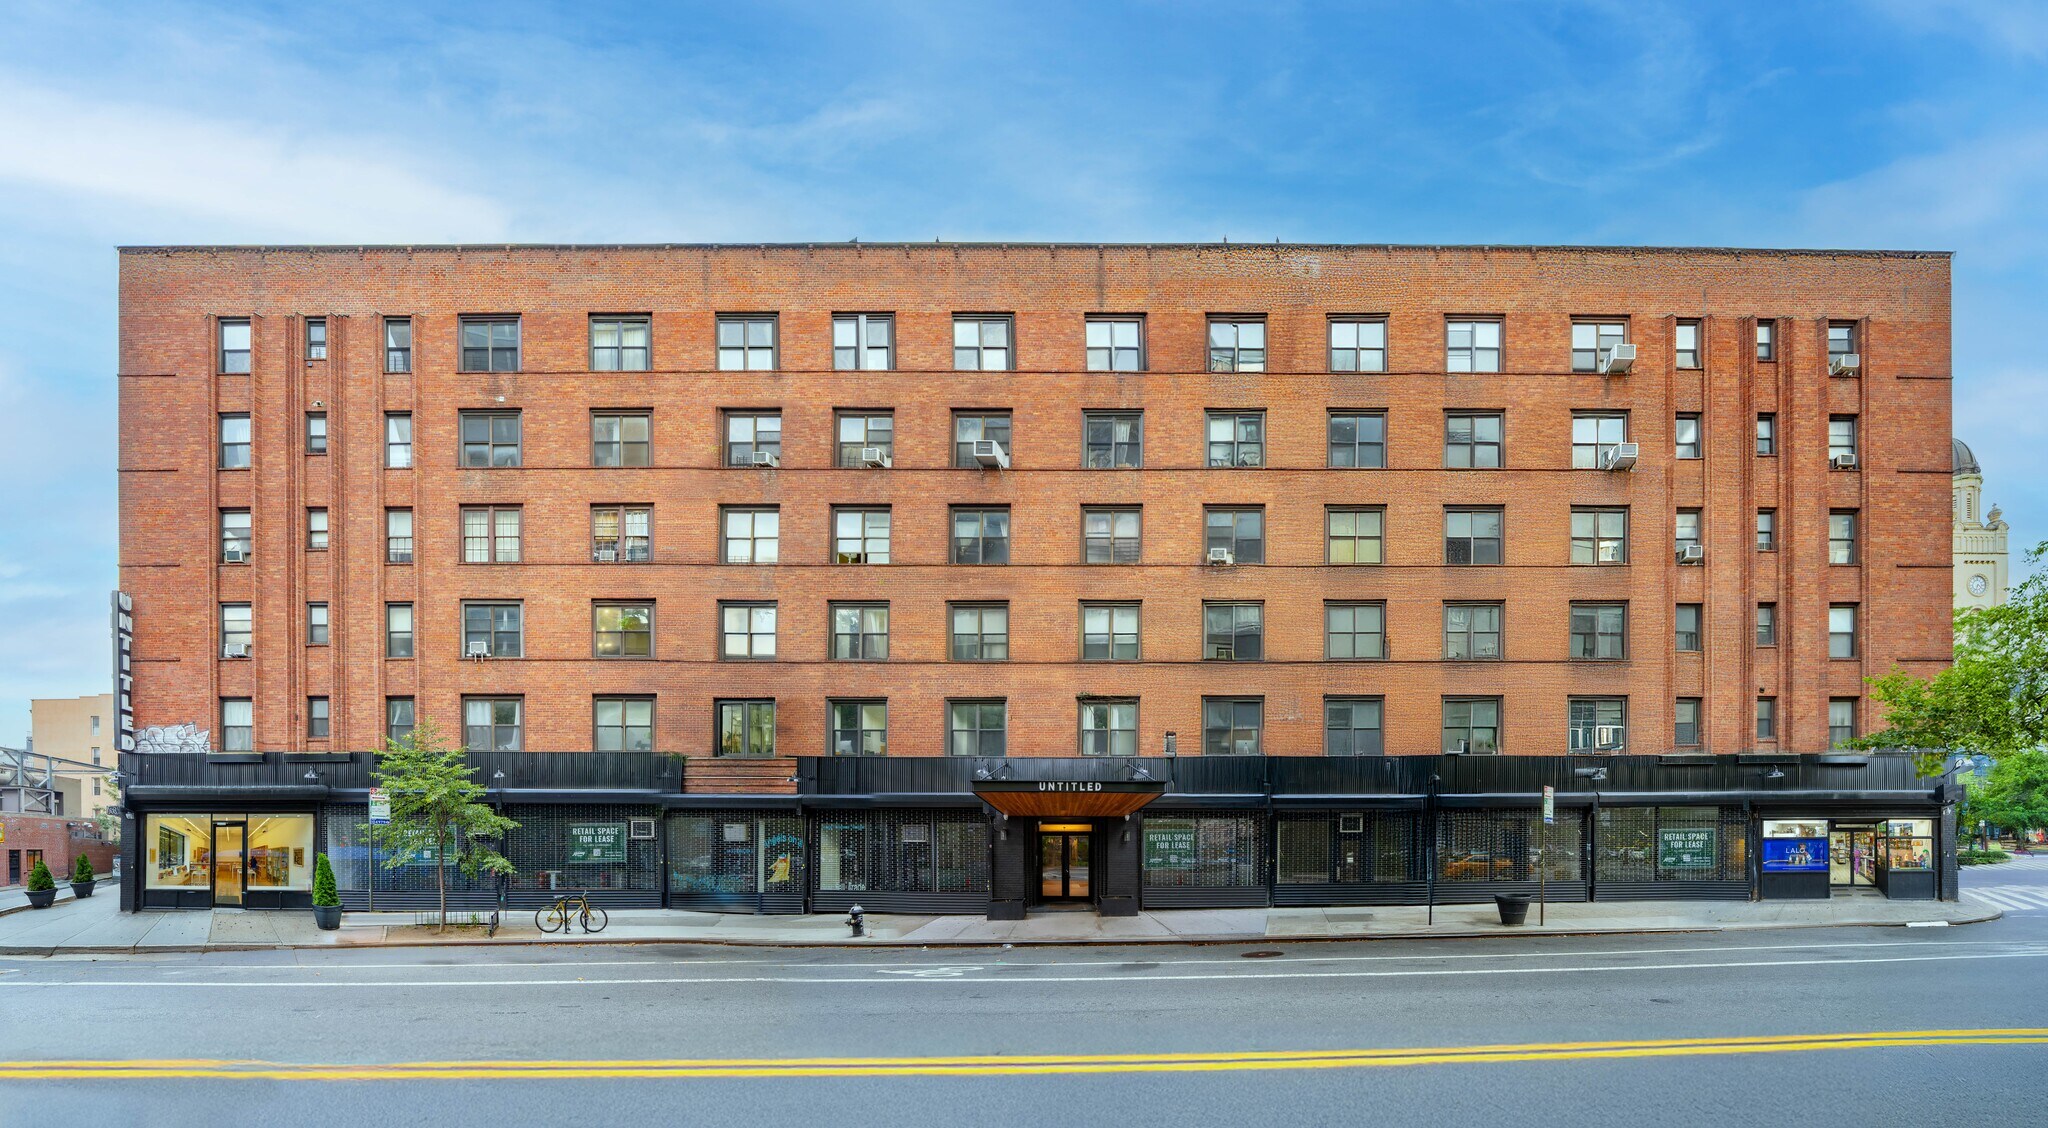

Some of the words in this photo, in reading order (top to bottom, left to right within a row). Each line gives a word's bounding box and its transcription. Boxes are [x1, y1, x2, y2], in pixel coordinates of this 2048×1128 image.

[118, 591, 135, 751] UNTITLED
[1039, 781, 1102, 791] UNTITLED
[597, 827, 619, 835] SPACE
[594, 835, 615, 843] LEASE
[1149, 833, 1173, 841] RETAIL
[1174, 833, 1194, 841] SPACE
[1664, 833, 1687, 841] RETAIL
[1688, 832, 1709, 841] SPACE
[1156, 841, 1169, 849] FOR
[1171, 841, 1190, 849] LEASE
[1670, 840, 1683, 849] FOR
[1684, 840, 1704, 848] LEASE
